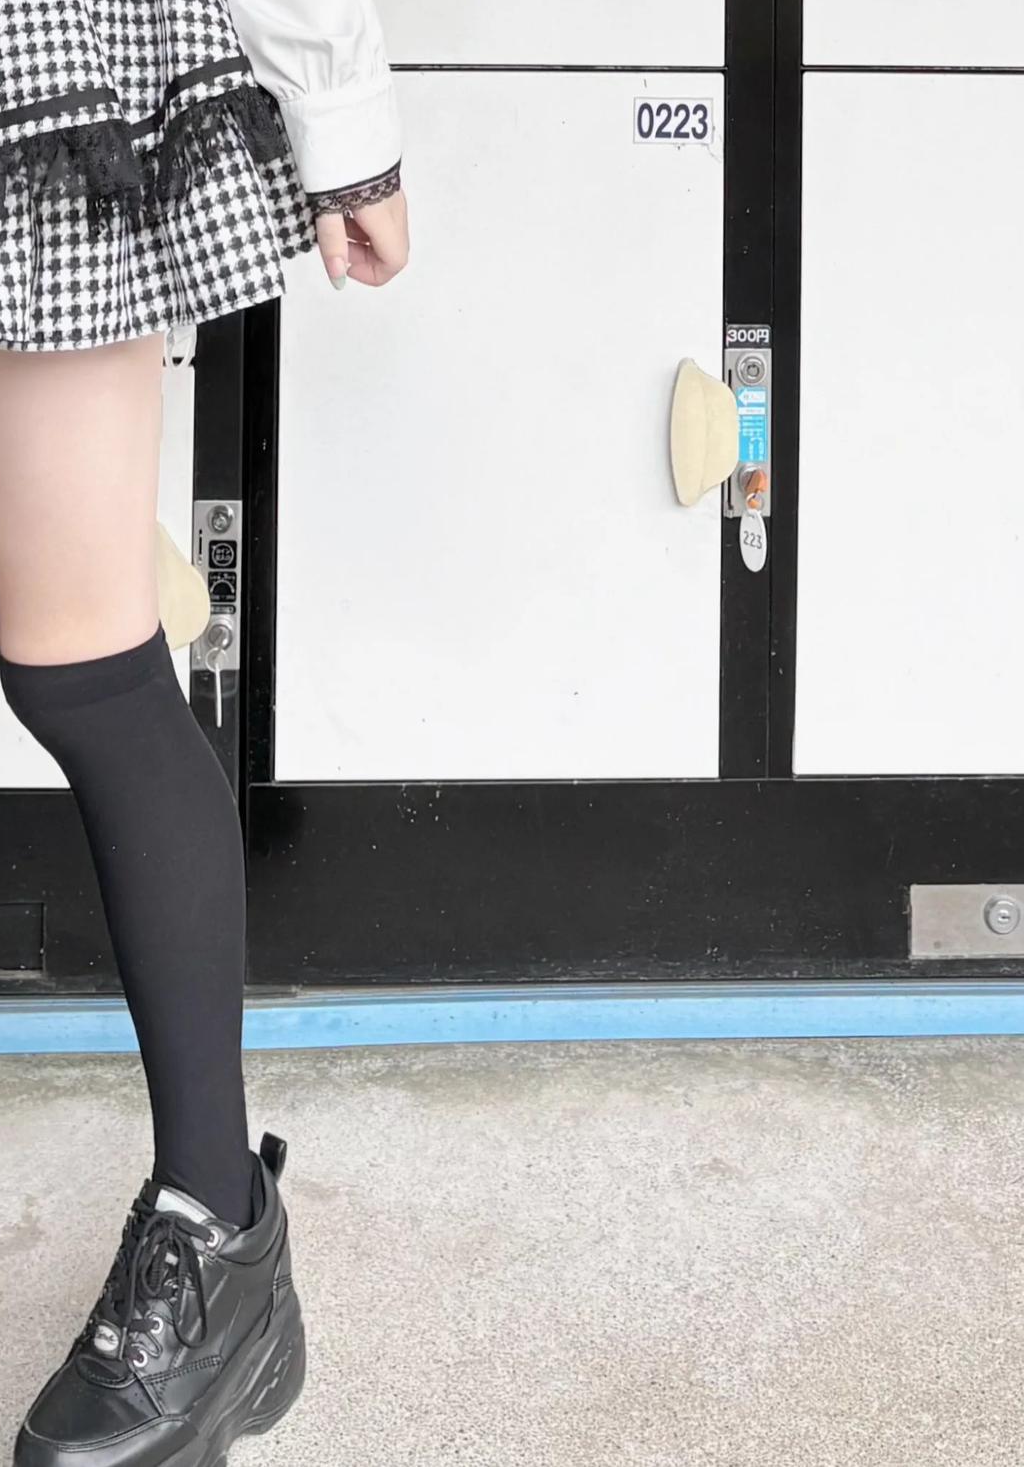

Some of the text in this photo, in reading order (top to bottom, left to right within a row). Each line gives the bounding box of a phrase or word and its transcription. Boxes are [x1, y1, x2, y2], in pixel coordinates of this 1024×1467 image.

[637, 102, 708, 140] 0223
[727, 329, 769, 343] 300円
[743, 530, 763, 549] 223
